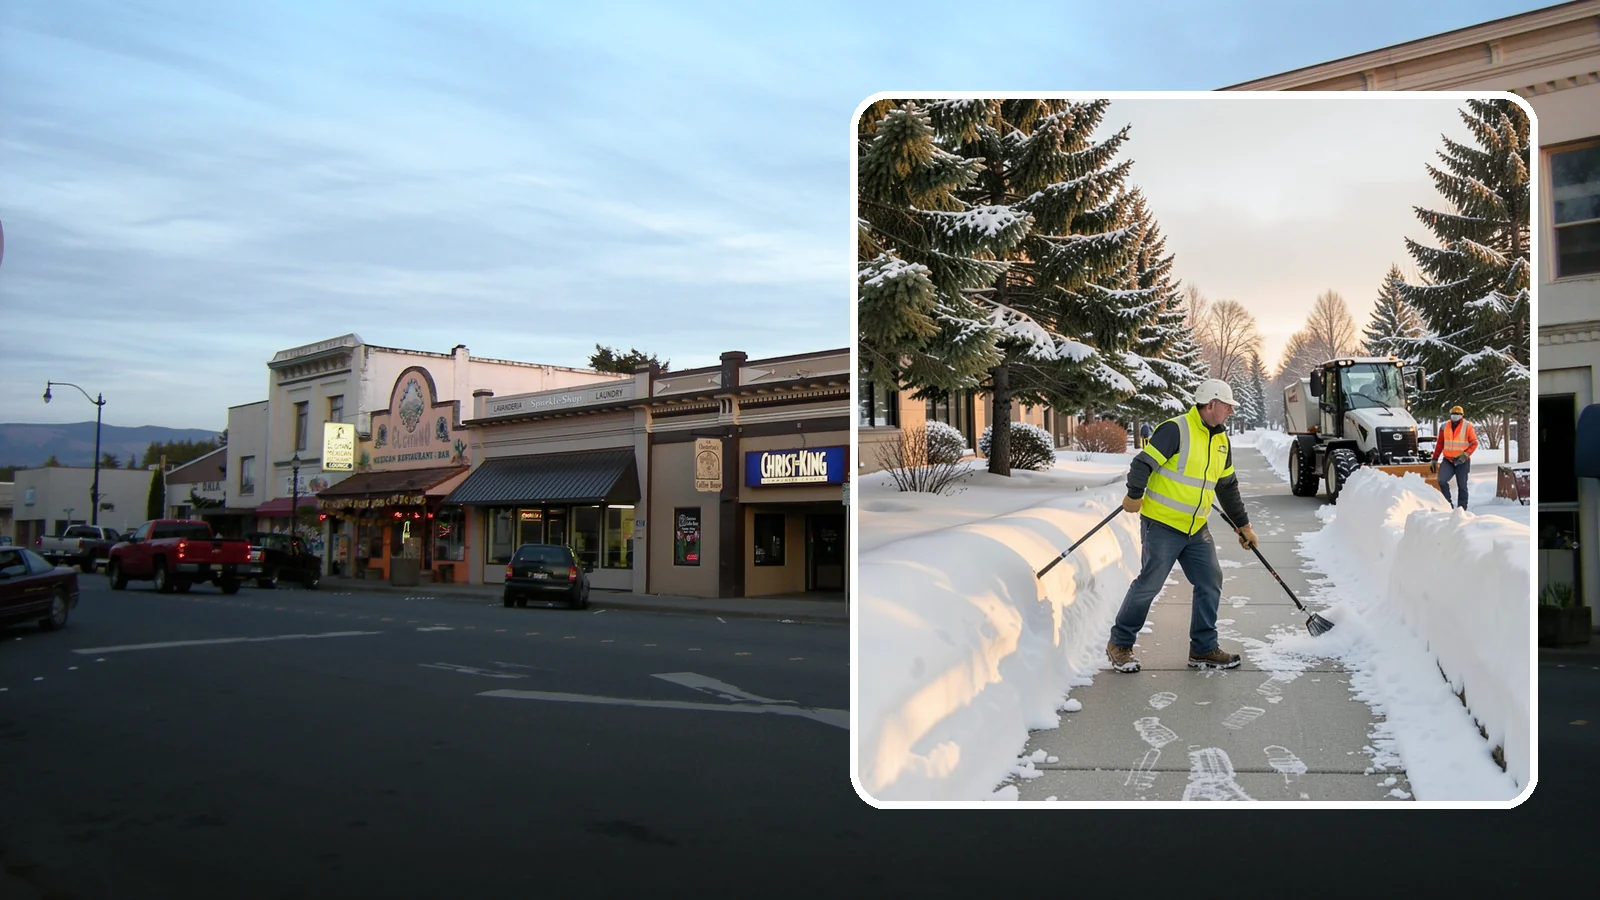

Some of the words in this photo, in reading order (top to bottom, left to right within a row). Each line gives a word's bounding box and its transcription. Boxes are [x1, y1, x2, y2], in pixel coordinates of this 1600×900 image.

[560, 394, 582, 405] Shop
[595, 389, 624, 400] LAUNDRY
[397, 451, 433, 462] RESTAURANT
[437, 450, 450, 459] BAR
[761, 452, 797, 478] CHRIST
[799, 450, 827, 476] KING
